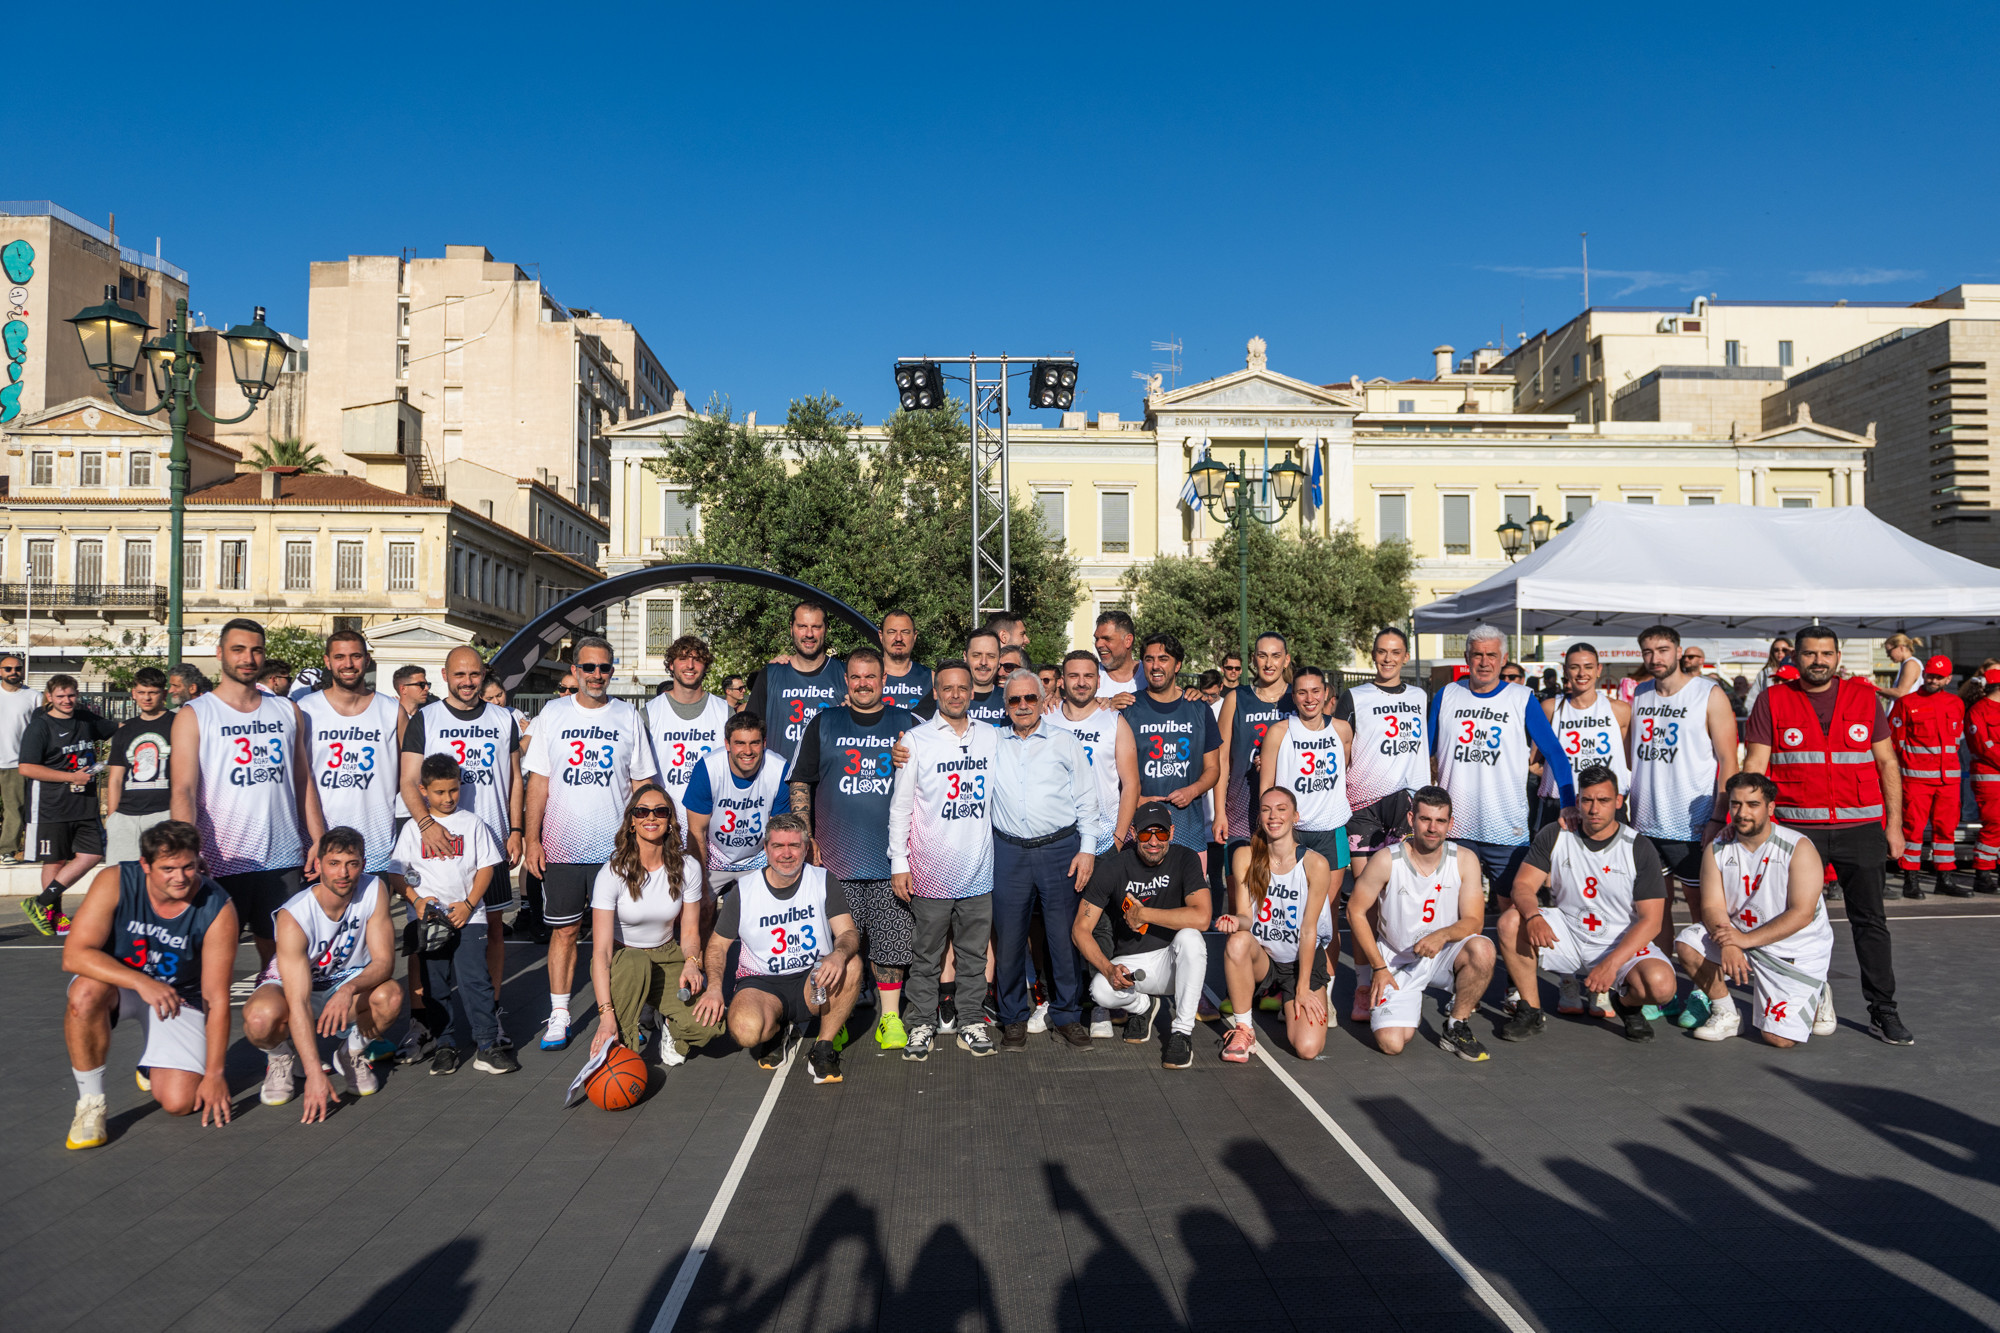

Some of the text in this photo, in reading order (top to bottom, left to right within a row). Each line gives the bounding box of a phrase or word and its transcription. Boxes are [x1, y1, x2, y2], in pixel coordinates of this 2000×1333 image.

[1175, 418, 1335, 427] ΕΘΝΙΚΗ ΤΡΑΠΕΖΑ ΤΗΣ ΕΛΛΑΔΟΣ
[782, 686, 834, 698] novibet
[883, 683, 922, 695] ovibet
[789, 699, 817, 723] 3 ON
[970, 706, 1006, 719] vibet
[1373, 702, 1422, 715] novibet
[1454, 707, 1509, 723] novibet
[1637, 704, 1688, 718] novibet
[221, 720, 284, 736] novibet
[440, 725, 500, 739] novibet
[1140, 720, 1192, 734] novibet
[1384, 715, 1422, 738] 3 ON 3
[1560, 716, 1611, 729] novibet
[1641, 718, 1679, 746] 3 ON 3
[318, 727, 381, 742] novibet
[561, 726, 619, 741] novibet
[664, 729, 716, 741] novibet
[836, 735, 896, 747] novibet
[1074, 729, 1100, 742] ibet
[1458, 720, 1502, 749] 3 ON 3
[1565, 731, 1611, 755] 3 ON 3
[234, 737, 283, 765] 3 ON 3
[327, 742, 374, 771] 3 ON 3
[450, 740, 495, 767] 3 ON 3
[568, 740, 613, 769] 3 ON 3
[672, 743, 685, 766] 3
[686, 751, 698, 761] ON
[1149, 735, 1190, 760] 3 ON 3
[1454, 745, 1501, 766] GLORY
[1637, 743, 1679, 764] GLORY
[66, 754, 78, 769] 3
[844, 749, 892, 777] 3 ON 3
[937, 757, 988, 773] novibet
[1145, 760, 1190, 778] GLORY
[1300, 752, 1337, 775] 3 ON 3
[230, 765, 285, 787] GLORY
[320, 771, 374, 790] GLORY
[461, 769, 494, 786] ORY
[563, 767, 614, 787] GLORY
[667, 768, 692, 785] GLO
[839, 776, 893, 795] GLORY
[1294, 774, 1338, 794] GLORY
[947, 773, 985, 800] 3 ON 3
[718, 796, 765, 810] novibet
[941, 802, 985, 820] GLORY
[720, 810, 763, 834] 3 ON 3
[40, 840, 51, 855] 11
[715, 832, 763, 848] GLORY
[1268, 884, 1299, 900] vibe
[1582, 876, 1598, 898] 8
[759, 904, 815, 927] novibet
[1257, 898, 1297, 929] 3 ON 3
[1422, 899, 1436, 923] 5
[771, 925, 817, 954] 3 ON 3
[1252, 922, 1300, 944] GLORY
[123, 939, 147, 967] 3
[157, 952, 179, 976] 3
[1764, 997, 1787, 1022] 14
